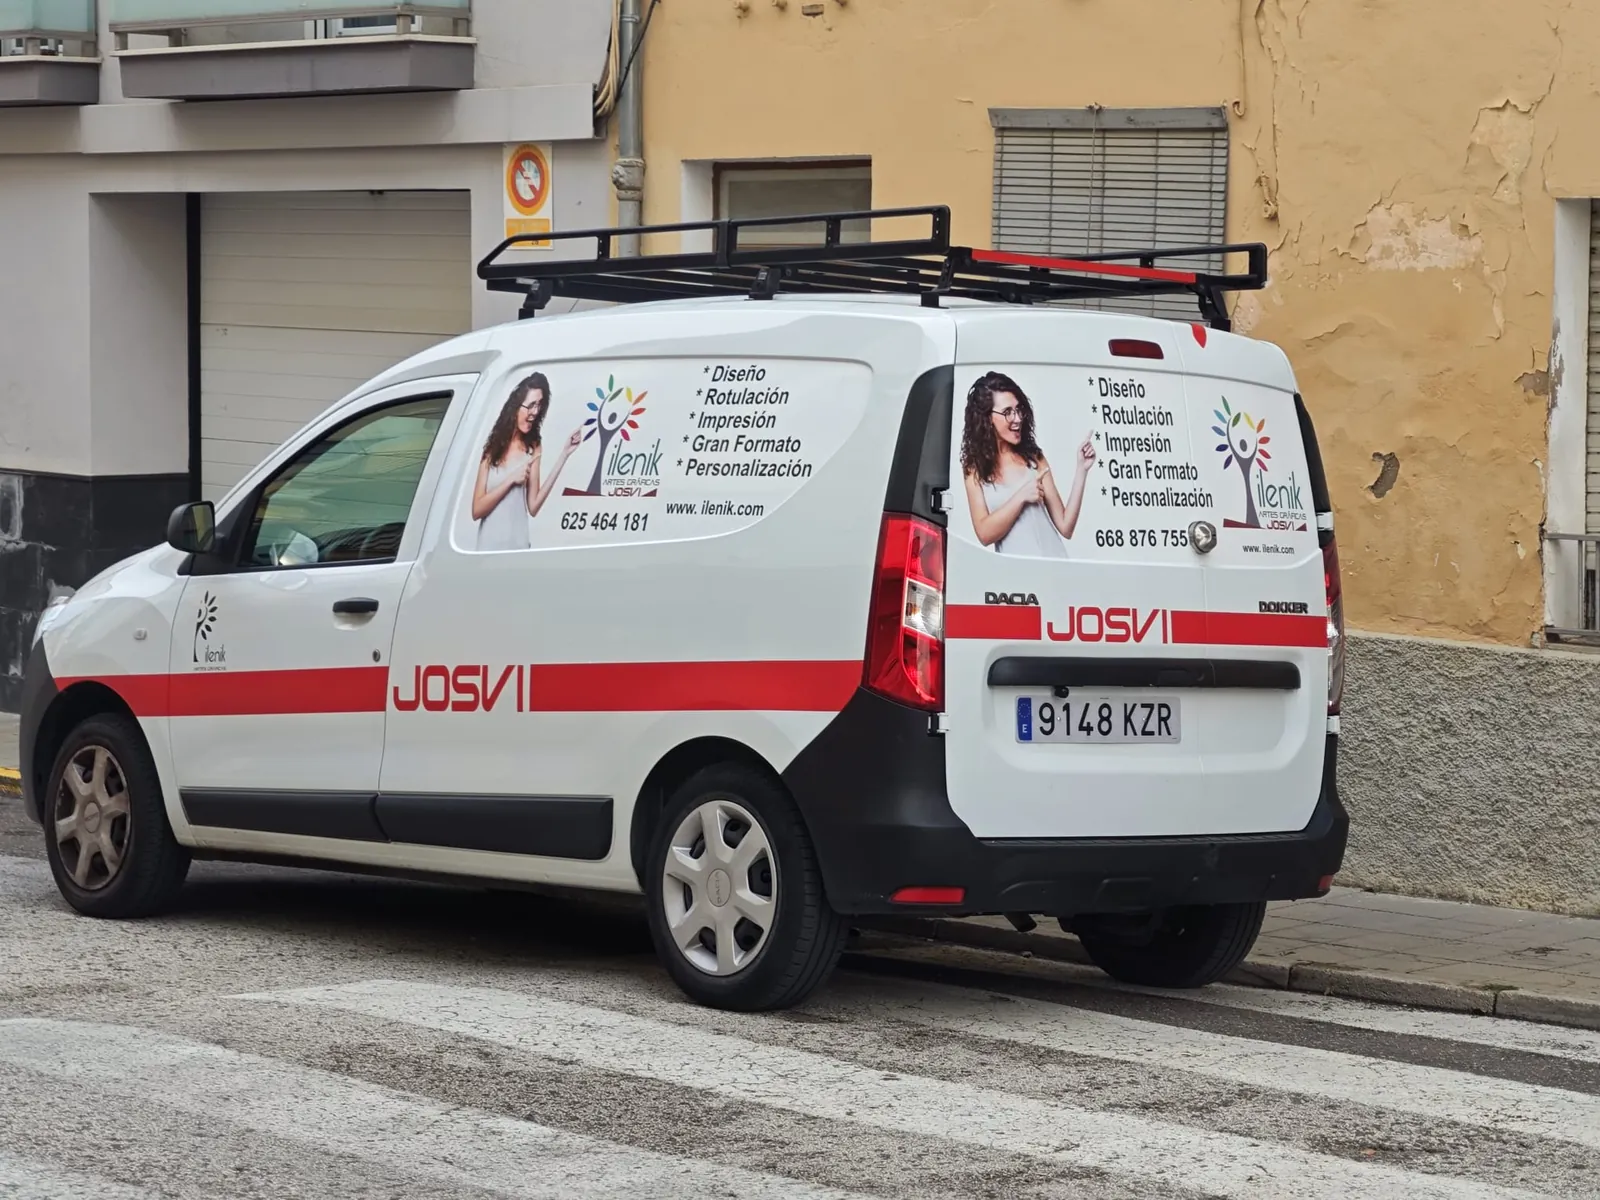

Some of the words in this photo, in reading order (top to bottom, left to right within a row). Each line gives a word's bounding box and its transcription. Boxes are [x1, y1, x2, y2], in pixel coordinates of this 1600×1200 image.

[711, 365, 766, 382] Diseño
[704, 387, 789, 405] Rotulación
[1098, 377, 1146, 398] Diseño
[697, 411, 776, 432] Impresión
[1102, 404, 1174, 426] Rotulación
[692, 434, 729, 452] Gran
[733, 435, 801, 453] Formato
[1105, 432, 1172, 457] Impresión
[607, 438, 663, 476] ilenik
[685, 458, 812, 478] Personalización
[1108, 458, 1142, 480] Gran
[1145, 459, 1198, 480] Formato
[607, 487, 642, 497] JOSVI
[1111, 486, 1213, 508] Personalización
[1256, 468, 1303, 510] ilenik
[700, 500, 764, 516] ilenik.com
[560, 511, 588, 530] 625
[590, 512, 618, 531] 464
[623, 513, 649, 532] 181
[1266, 520, 1295, 532] JOSVI
[1096, 529, 1124, 548] 668
[1129, 529, 1157, 548] 876
[1161, 529, 1188, 548] 755
[985, 591, 1039, 605] DACIA
[1259, 600, 1309, 614] DOKKER
[1046, 606, 1168, 645] JOSVI
[393, 664, 524, 712] JOSVI
[1022, 724, 1028, 734] E
[1038, 702, 1113, 737] 9148
[1123, 702, 1172, 736] KZR
